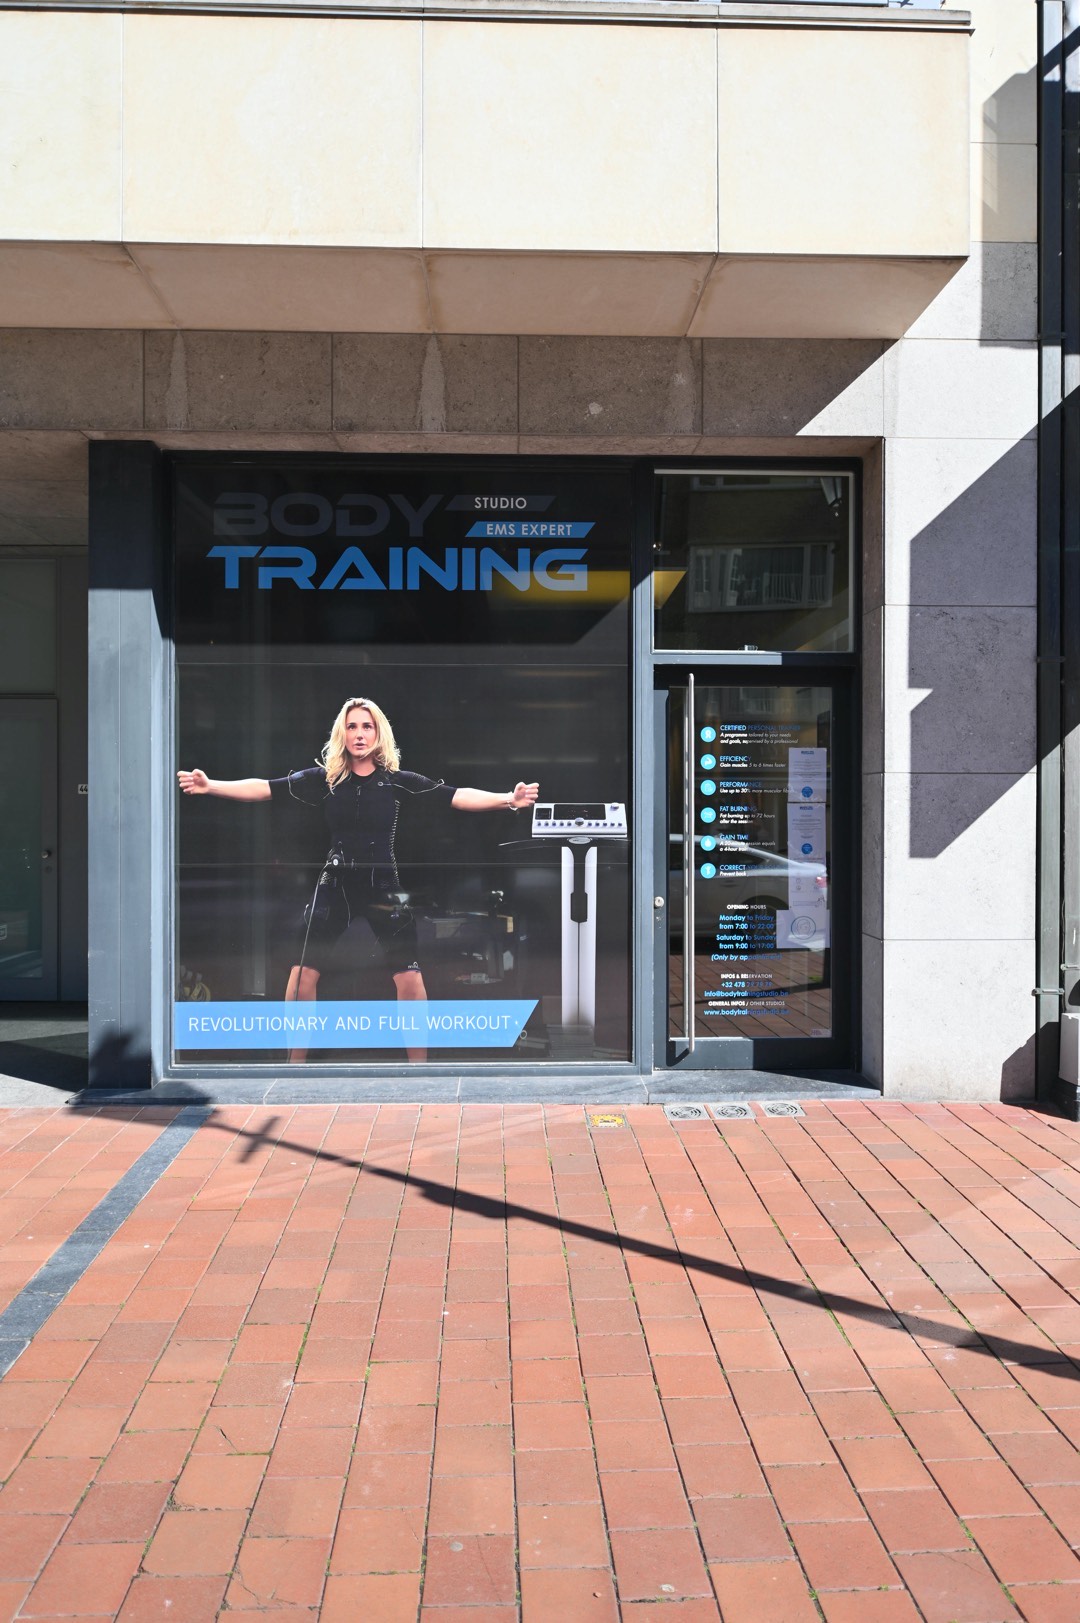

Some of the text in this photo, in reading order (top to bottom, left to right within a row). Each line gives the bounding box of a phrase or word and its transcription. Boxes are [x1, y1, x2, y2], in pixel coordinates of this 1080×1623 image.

[474, 496, 528, 510] STUDIO
[212, 493, 445, 537] BODY
[486, 523, 573, 536] EMS EXPERT
[206, 546, 589, 592] TRAINING
[188, 1015, 511, 1032] REVOLUTIONARY AND FULL WORKOUT
